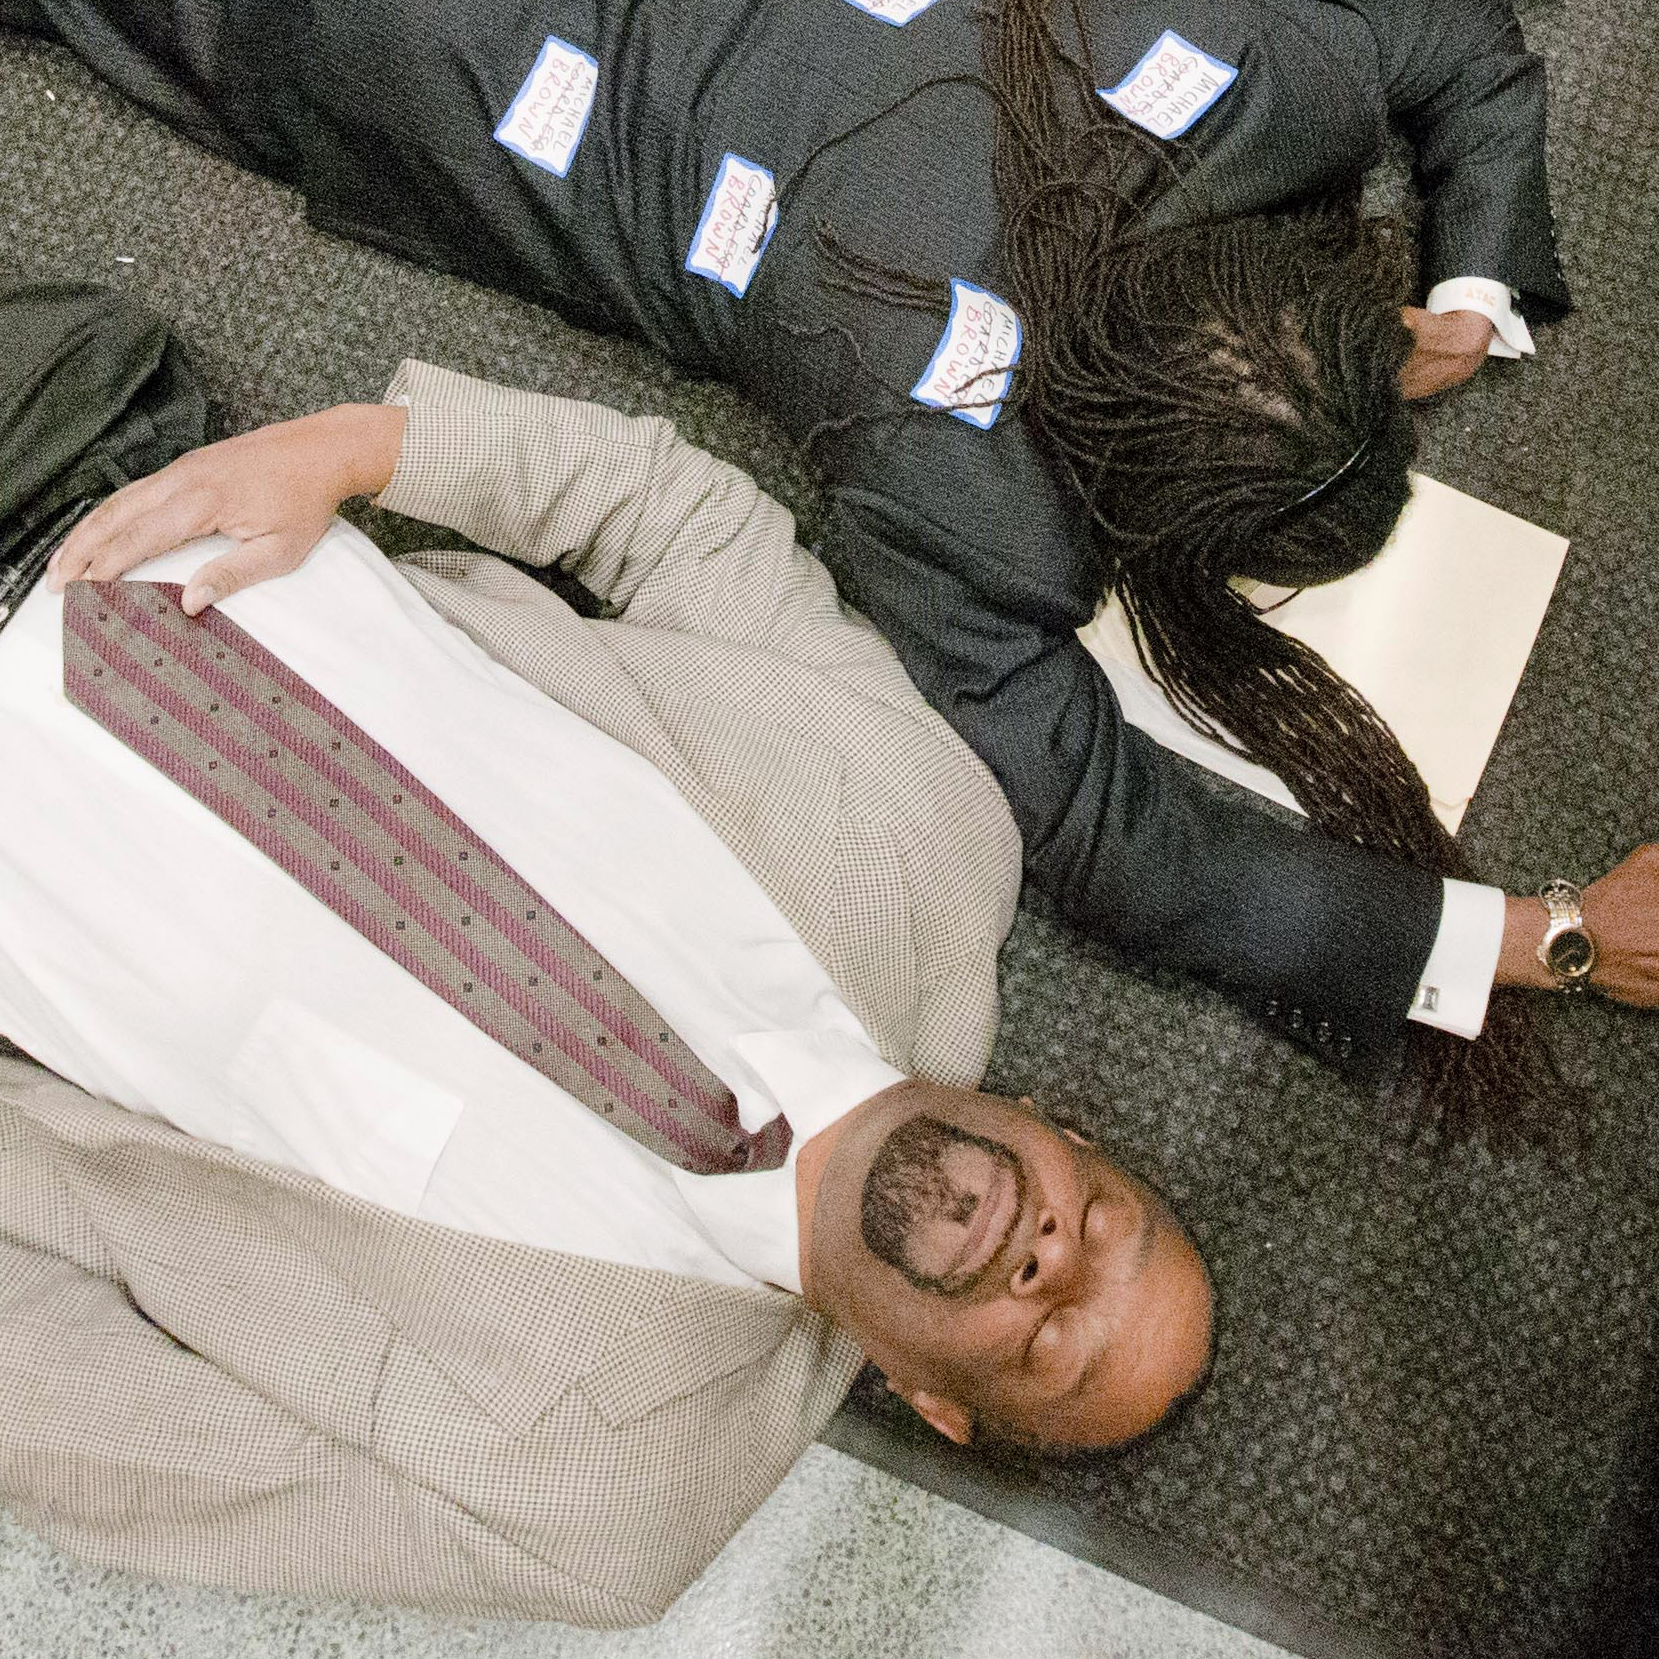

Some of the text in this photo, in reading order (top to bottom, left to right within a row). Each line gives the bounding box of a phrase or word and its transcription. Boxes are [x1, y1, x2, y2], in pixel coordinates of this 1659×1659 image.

[518, 58, 569, 139] BROWN
[552, 77, 593, 148] MICHAEL
[1119, 51, 1180, 109] BROWN
[1147, 72, 1220, 130] MICHAEL
[704, 175, 746, 261] BROWN
[933, 305, 982, 398] BROWN
